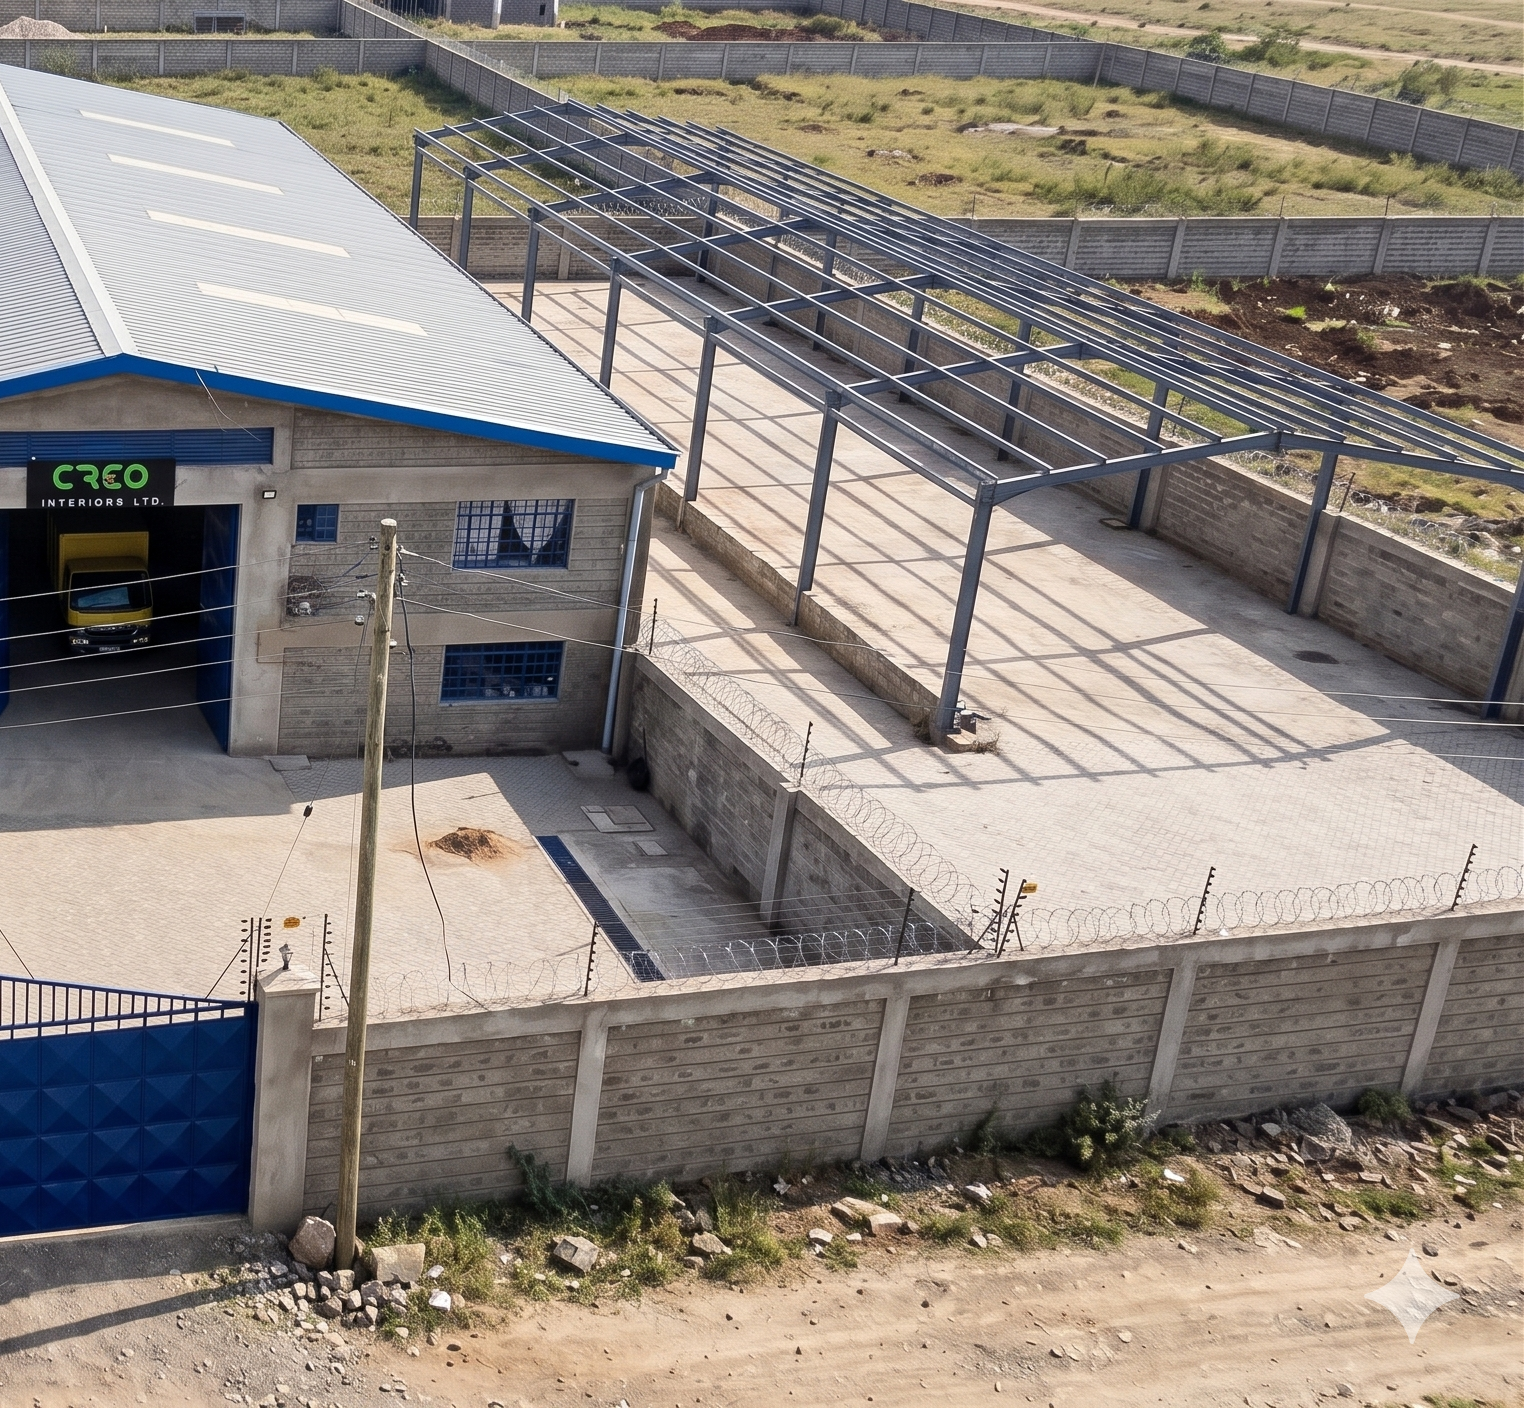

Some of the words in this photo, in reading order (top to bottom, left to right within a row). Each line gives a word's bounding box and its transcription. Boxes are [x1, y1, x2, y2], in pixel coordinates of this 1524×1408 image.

[52, 463, 149, 490] CREO
[41, 498, 124, 507] INTERIORS
[133, 497, 164, 506] LTD.
